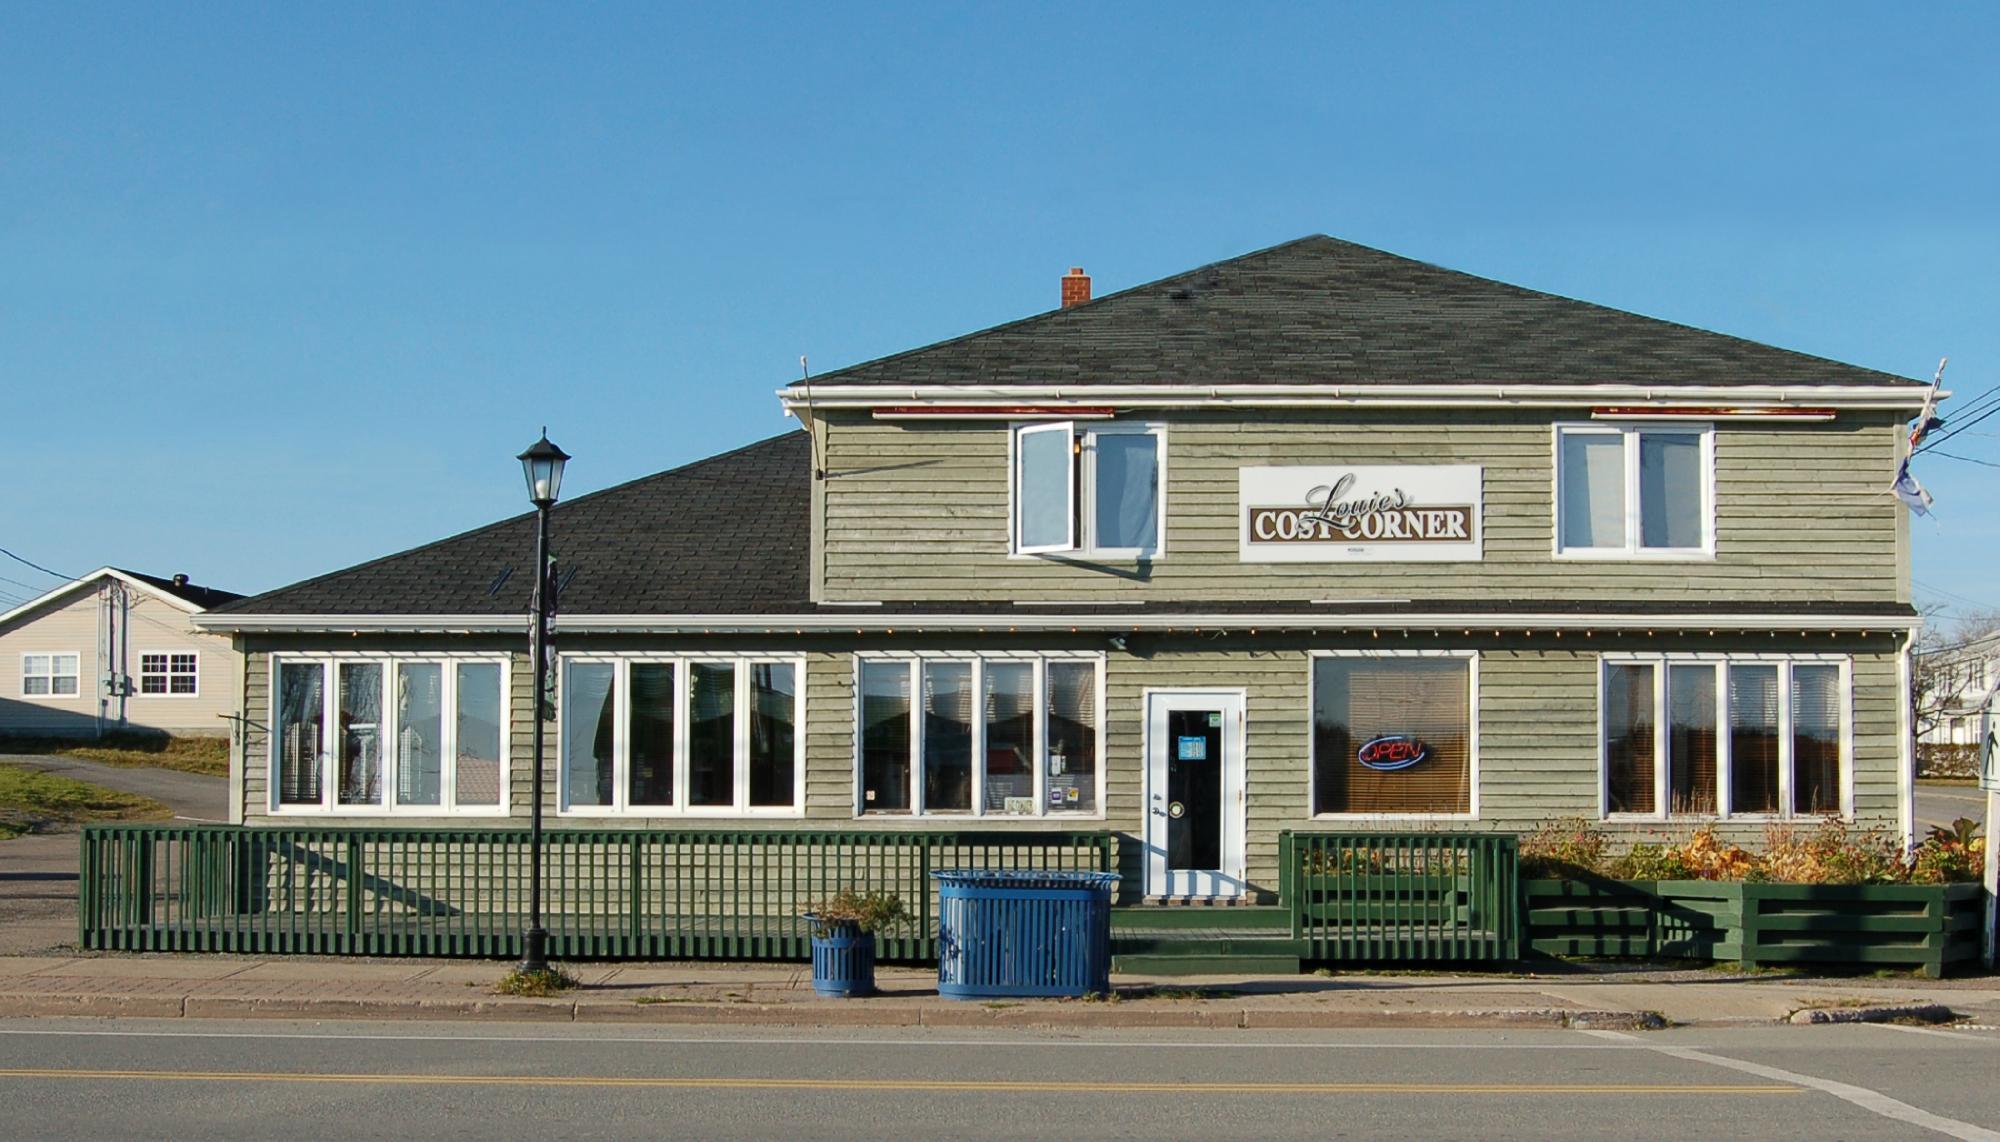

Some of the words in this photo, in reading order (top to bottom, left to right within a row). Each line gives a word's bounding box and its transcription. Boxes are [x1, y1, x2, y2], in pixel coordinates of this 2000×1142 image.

[1296, 472, 1411, 529] Louie's
[1339, 510, 1467, 539] CORNER
[1361, 742, 1421, 761] OPEN
